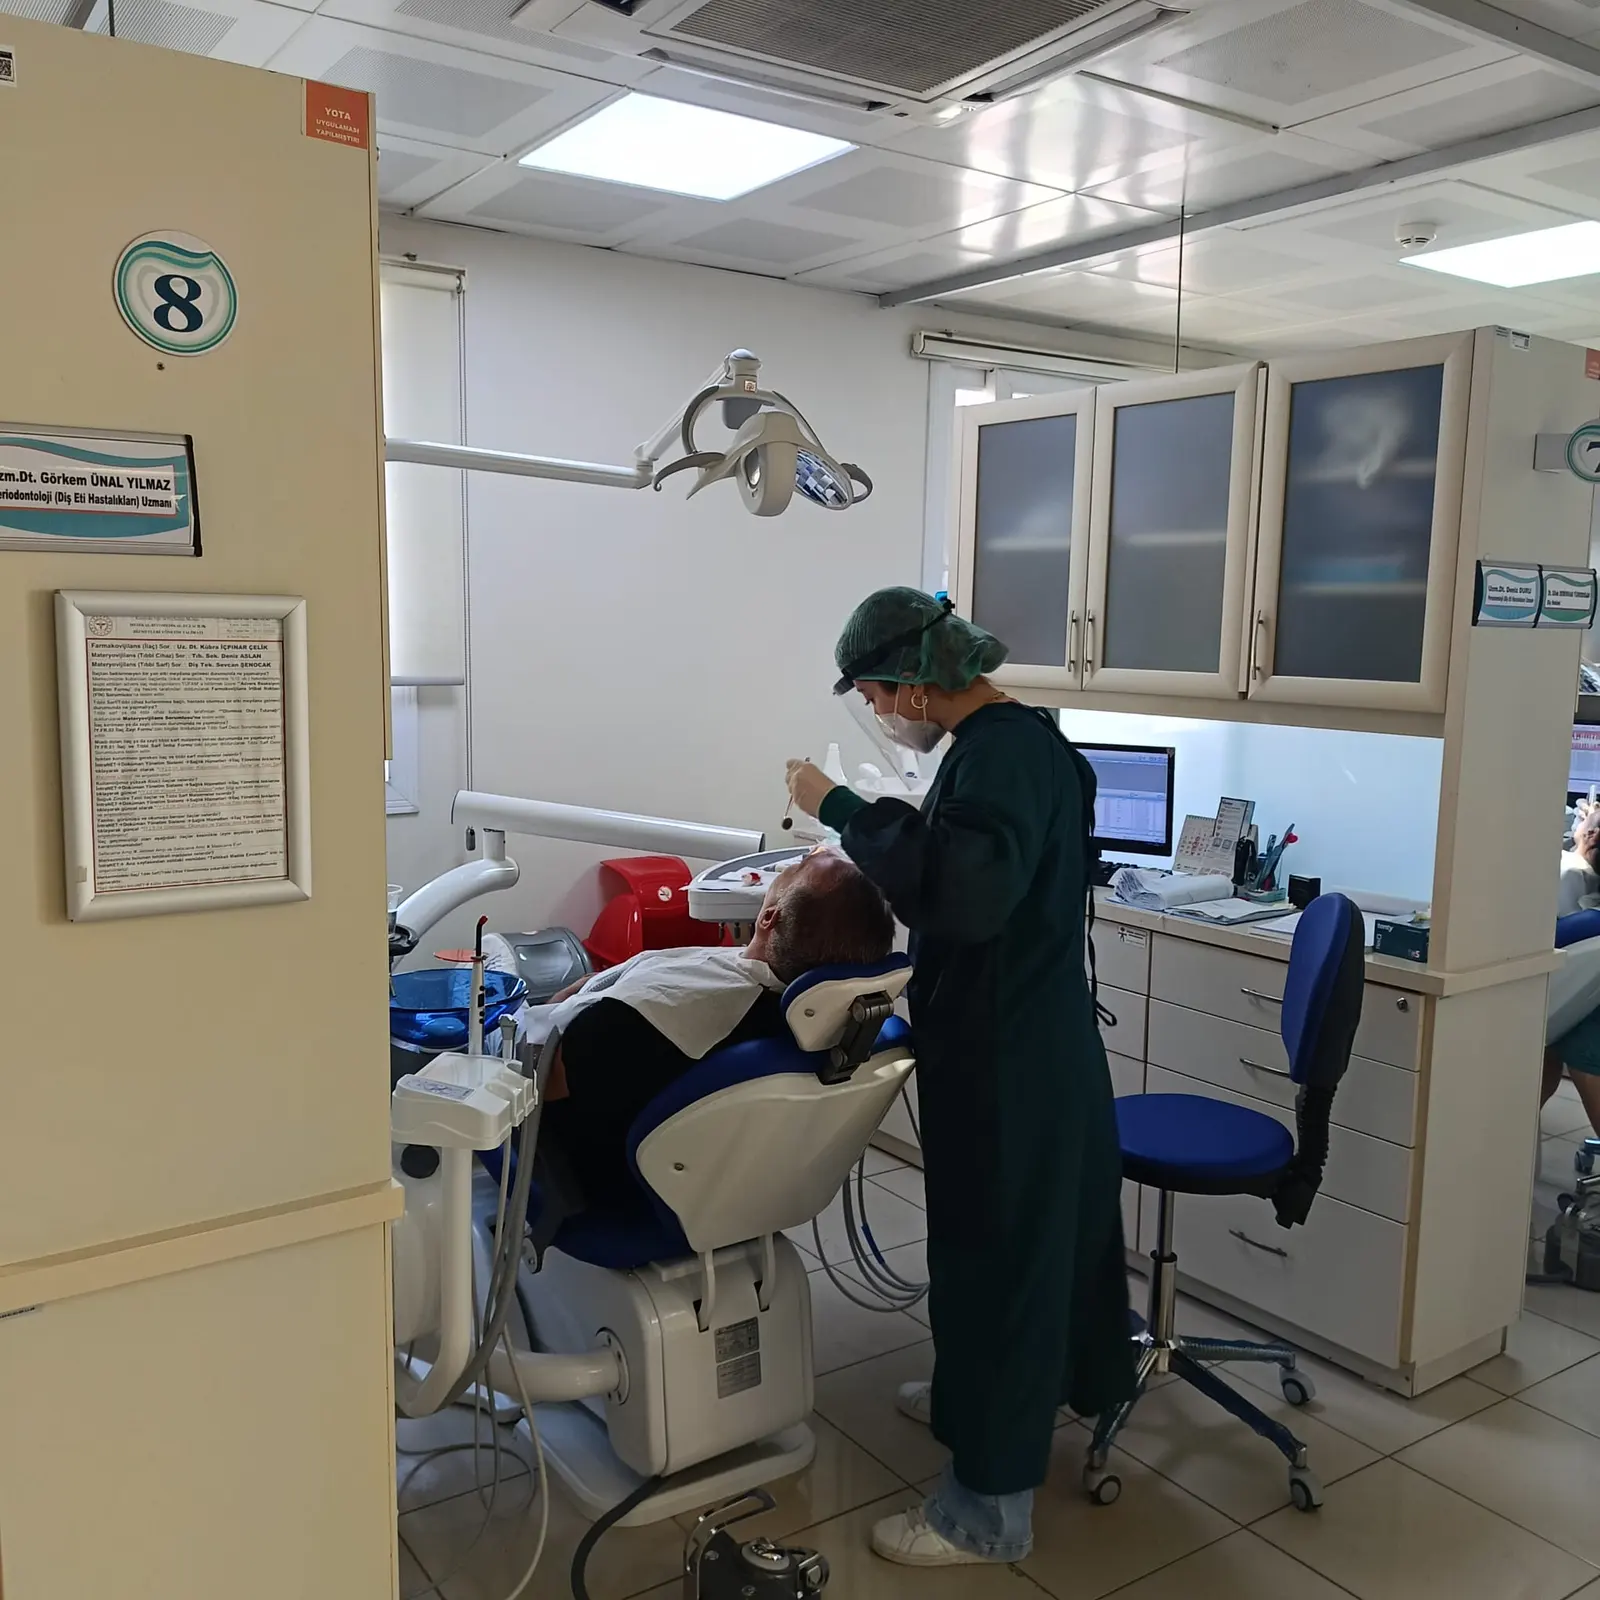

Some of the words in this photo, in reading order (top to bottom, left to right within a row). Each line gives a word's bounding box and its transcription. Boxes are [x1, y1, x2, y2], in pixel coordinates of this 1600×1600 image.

[324, 107, 352, 121] YOTA
[153, 274, 204, 333] 8
[40, 471, 88, 487] Görkem
[91, 472, 124, 489] ÜNAL
[126, 477, 171, 491] YILMAZ
[54, 491, 72, 506] (Diş
[74, 492, 86, 504] Eti
[141, 496, 172, 508] Uzmanı
